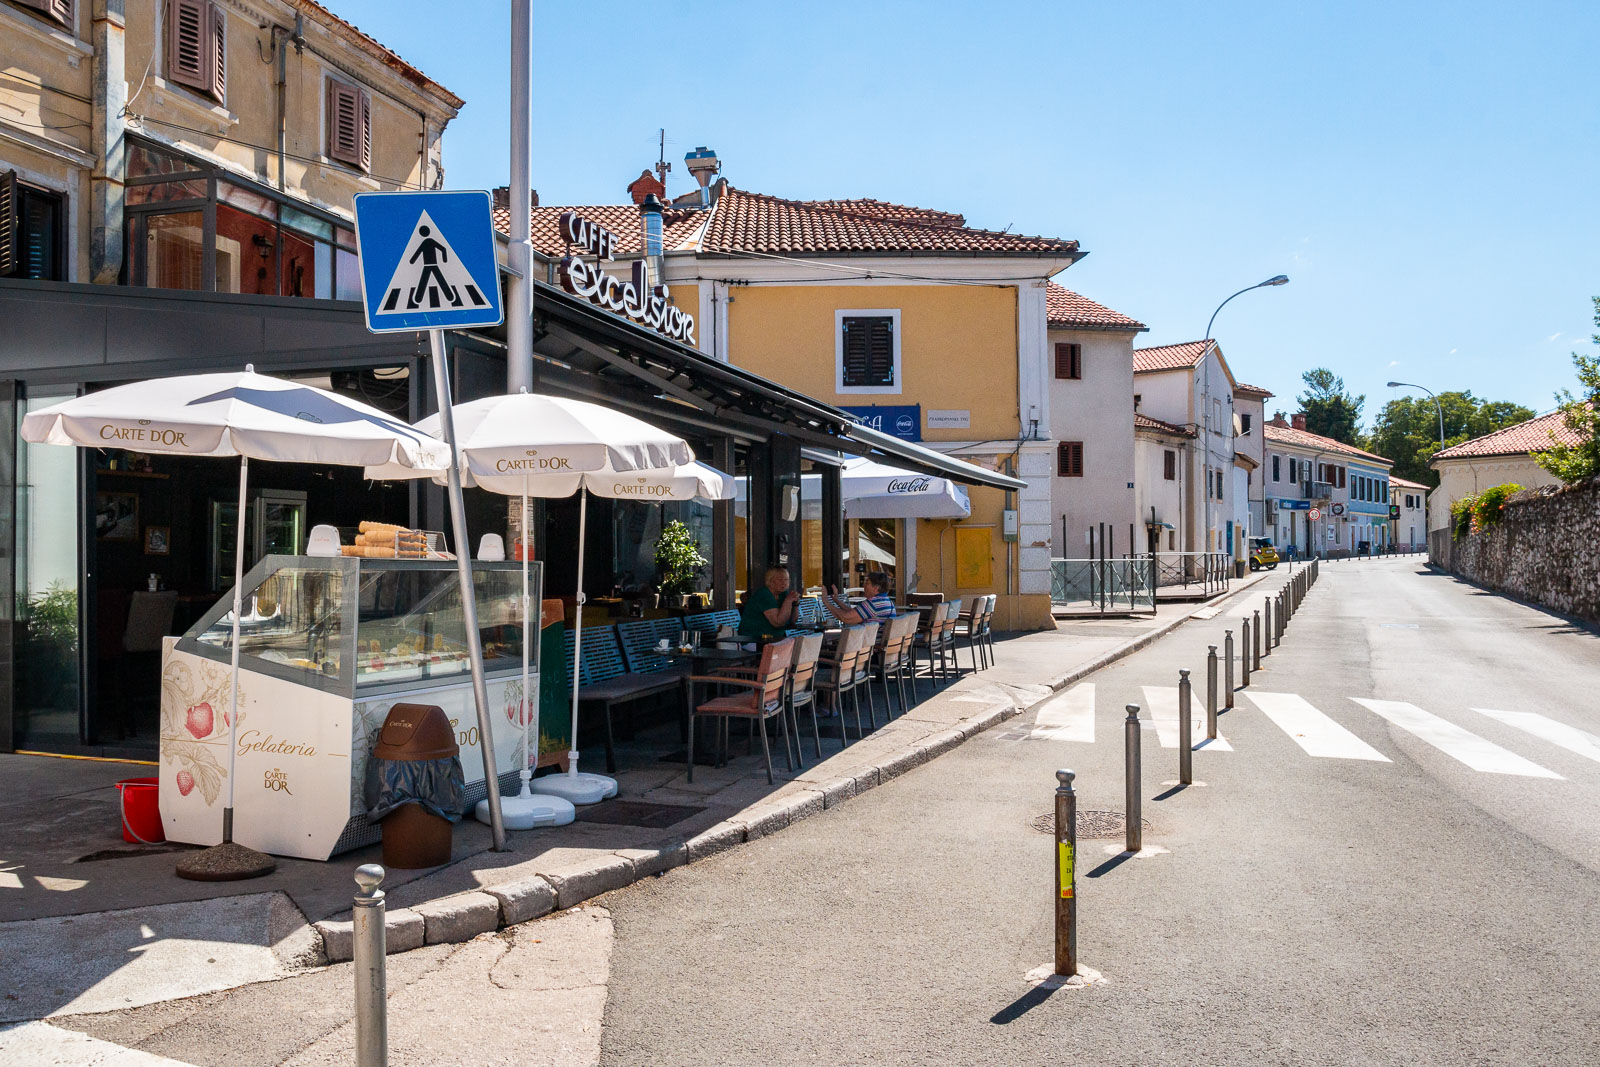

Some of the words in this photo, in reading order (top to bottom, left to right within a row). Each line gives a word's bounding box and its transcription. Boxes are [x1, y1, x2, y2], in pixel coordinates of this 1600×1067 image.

[561, 211, 619, 263] CAFFE
[563, 256, 697, 346] excelsior
[99, 424, 146, 441] CARTE
[150, 429, 190, 447] D'OR
[496, 459, 535, 473] CARTE
[539, 456, 573, 470] D'OR
[613, 483, 645, 496] CARTE
[647, 484, 675, 497] D'OR
[887, 477, 932, 494] Coca-Cola
[237, 729, 318, 757] Gelateria
[459, 726, 481, 746] D'O
[264, 770, 288, 780] CARTE
[264, 779, 293, 796] D'OR
